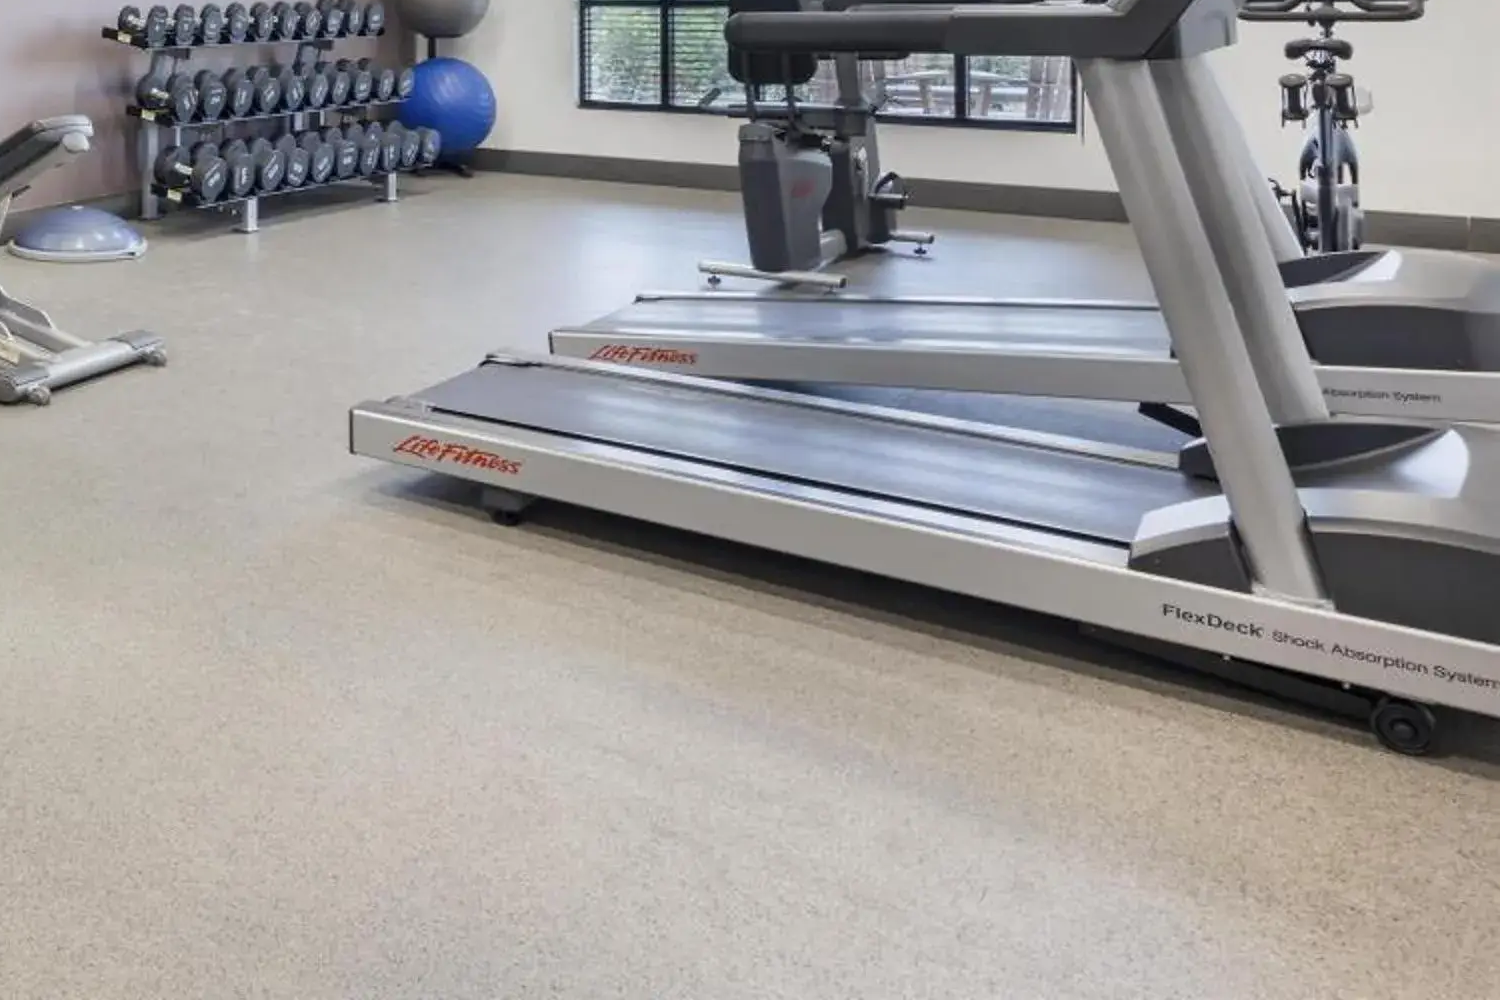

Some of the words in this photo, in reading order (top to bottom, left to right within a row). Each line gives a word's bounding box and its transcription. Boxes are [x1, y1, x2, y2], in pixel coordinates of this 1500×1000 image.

[1162, 602, 1264, 639] FlexDeck
[1271, 629, 1326, 652] Shock
[1331, 643, 1430, 675] Absorption
